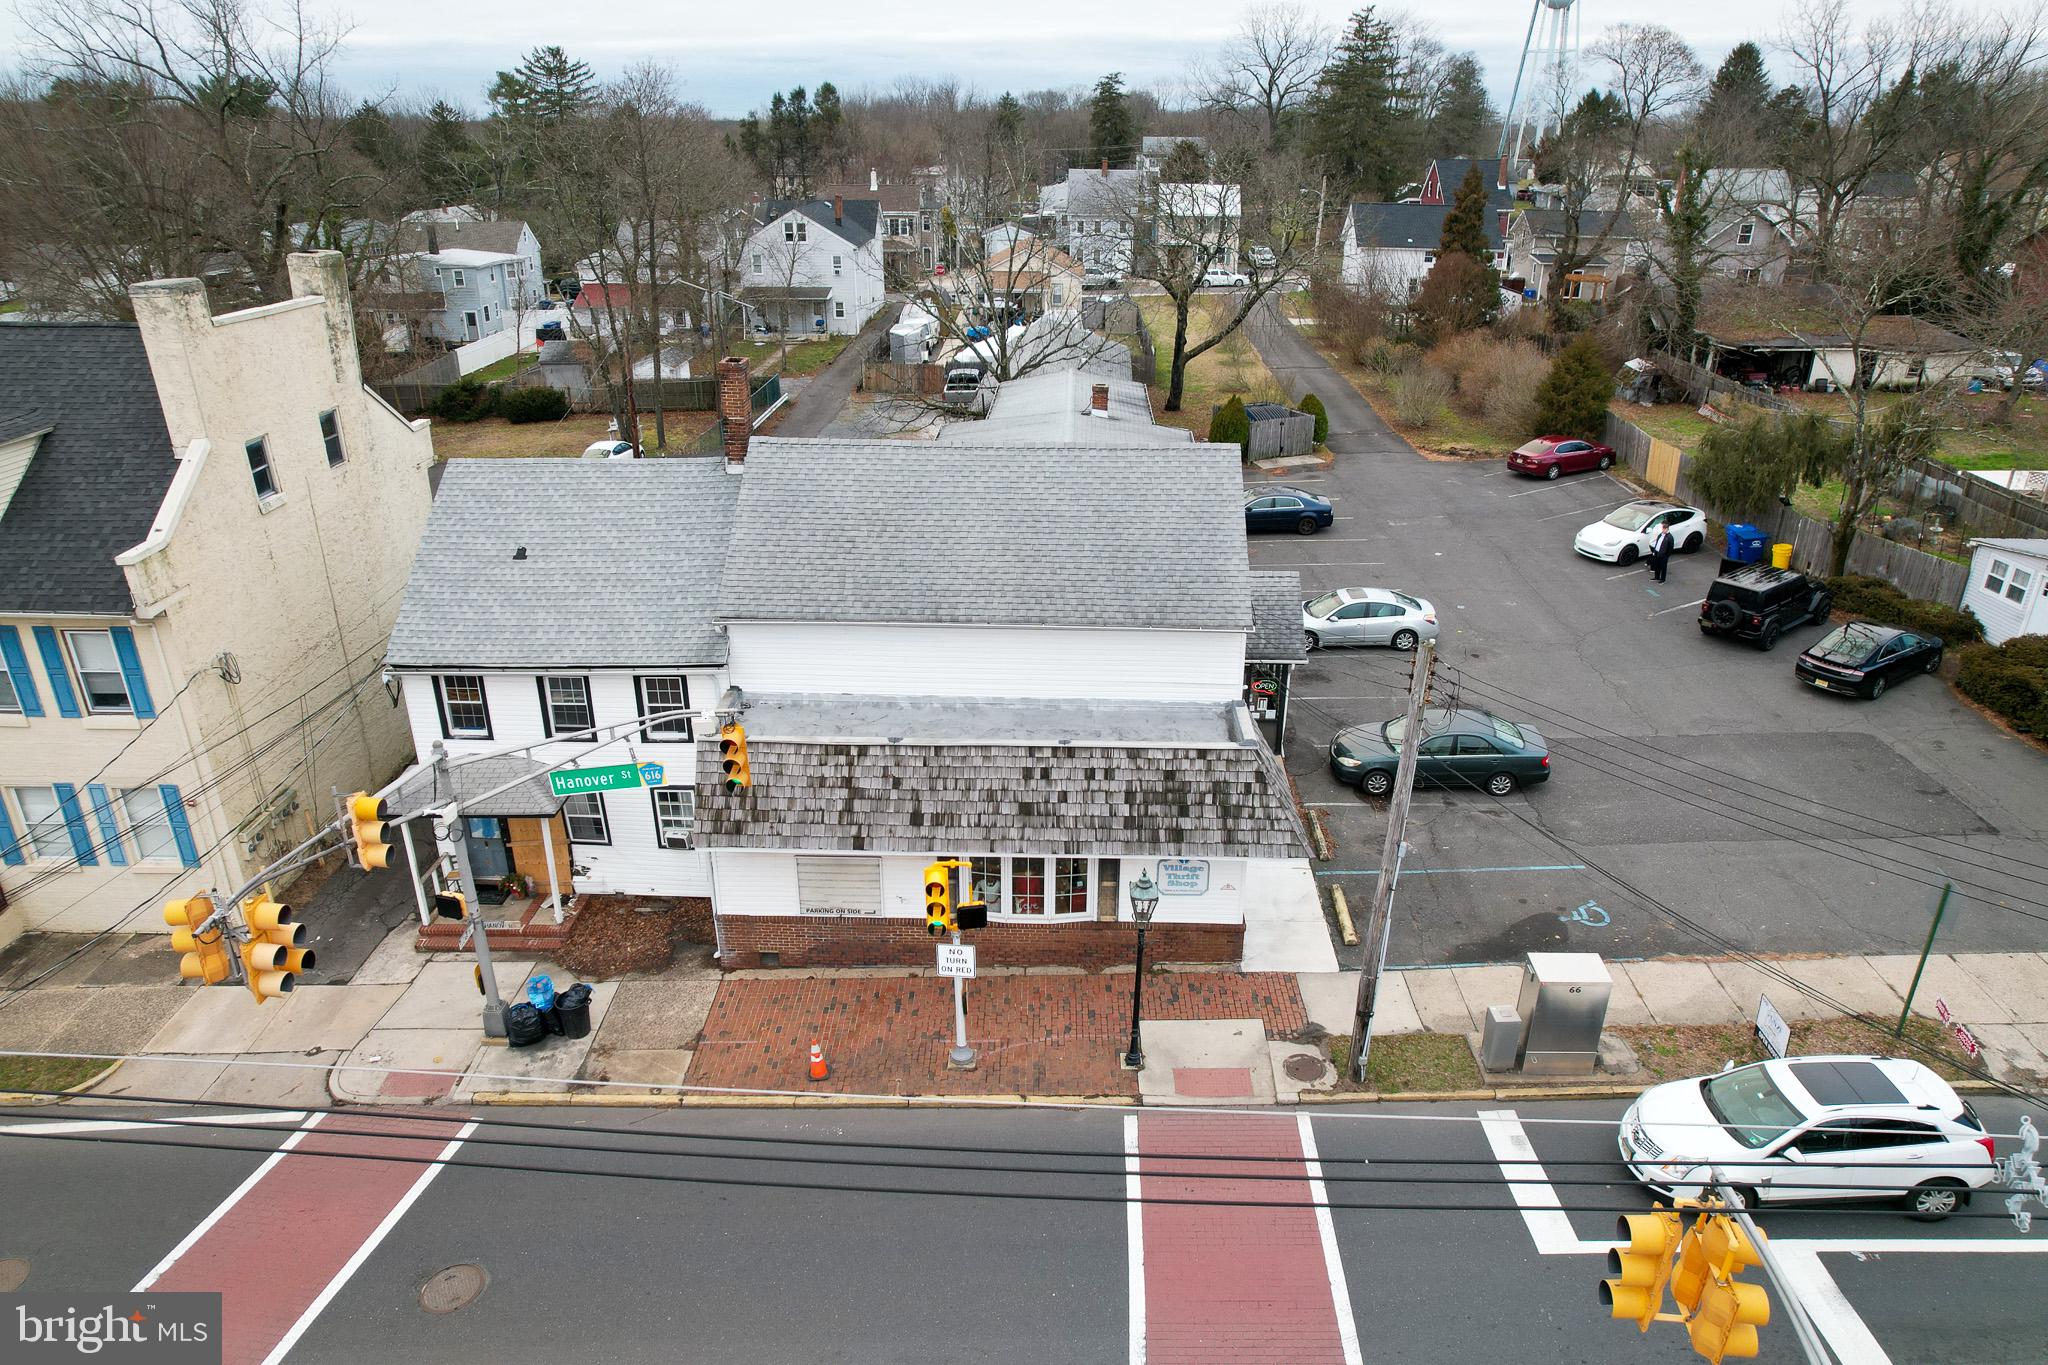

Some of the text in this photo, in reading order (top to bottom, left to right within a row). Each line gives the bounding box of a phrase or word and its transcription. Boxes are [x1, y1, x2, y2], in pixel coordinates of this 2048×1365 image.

[645, 770, 661, 780] 616
[555, 770, 632, 790] Hanover St
[1163, 864, 1204, 873] Village
[1167, 880, 1198, 888] Shop
